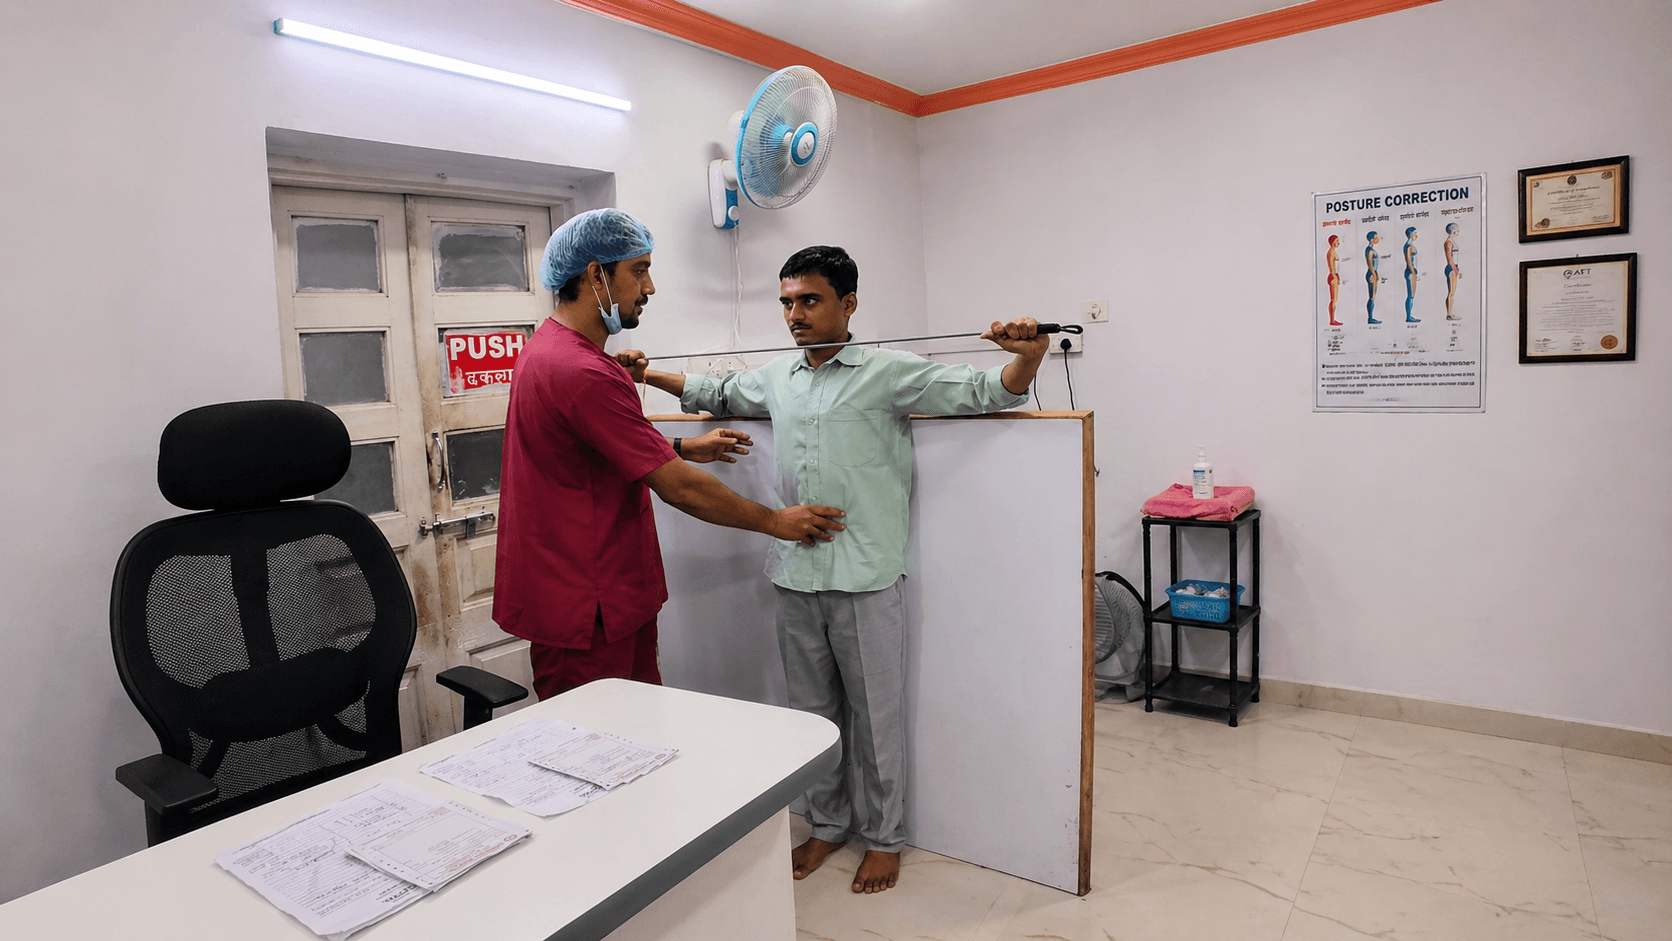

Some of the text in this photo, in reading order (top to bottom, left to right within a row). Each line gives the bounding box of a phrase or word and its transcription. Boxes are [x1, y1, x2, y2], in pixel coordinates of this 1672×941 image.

[1326, 187, 1469, 213] POSTURE CORRECTION
[450, 335, 524, 361] PUSH
